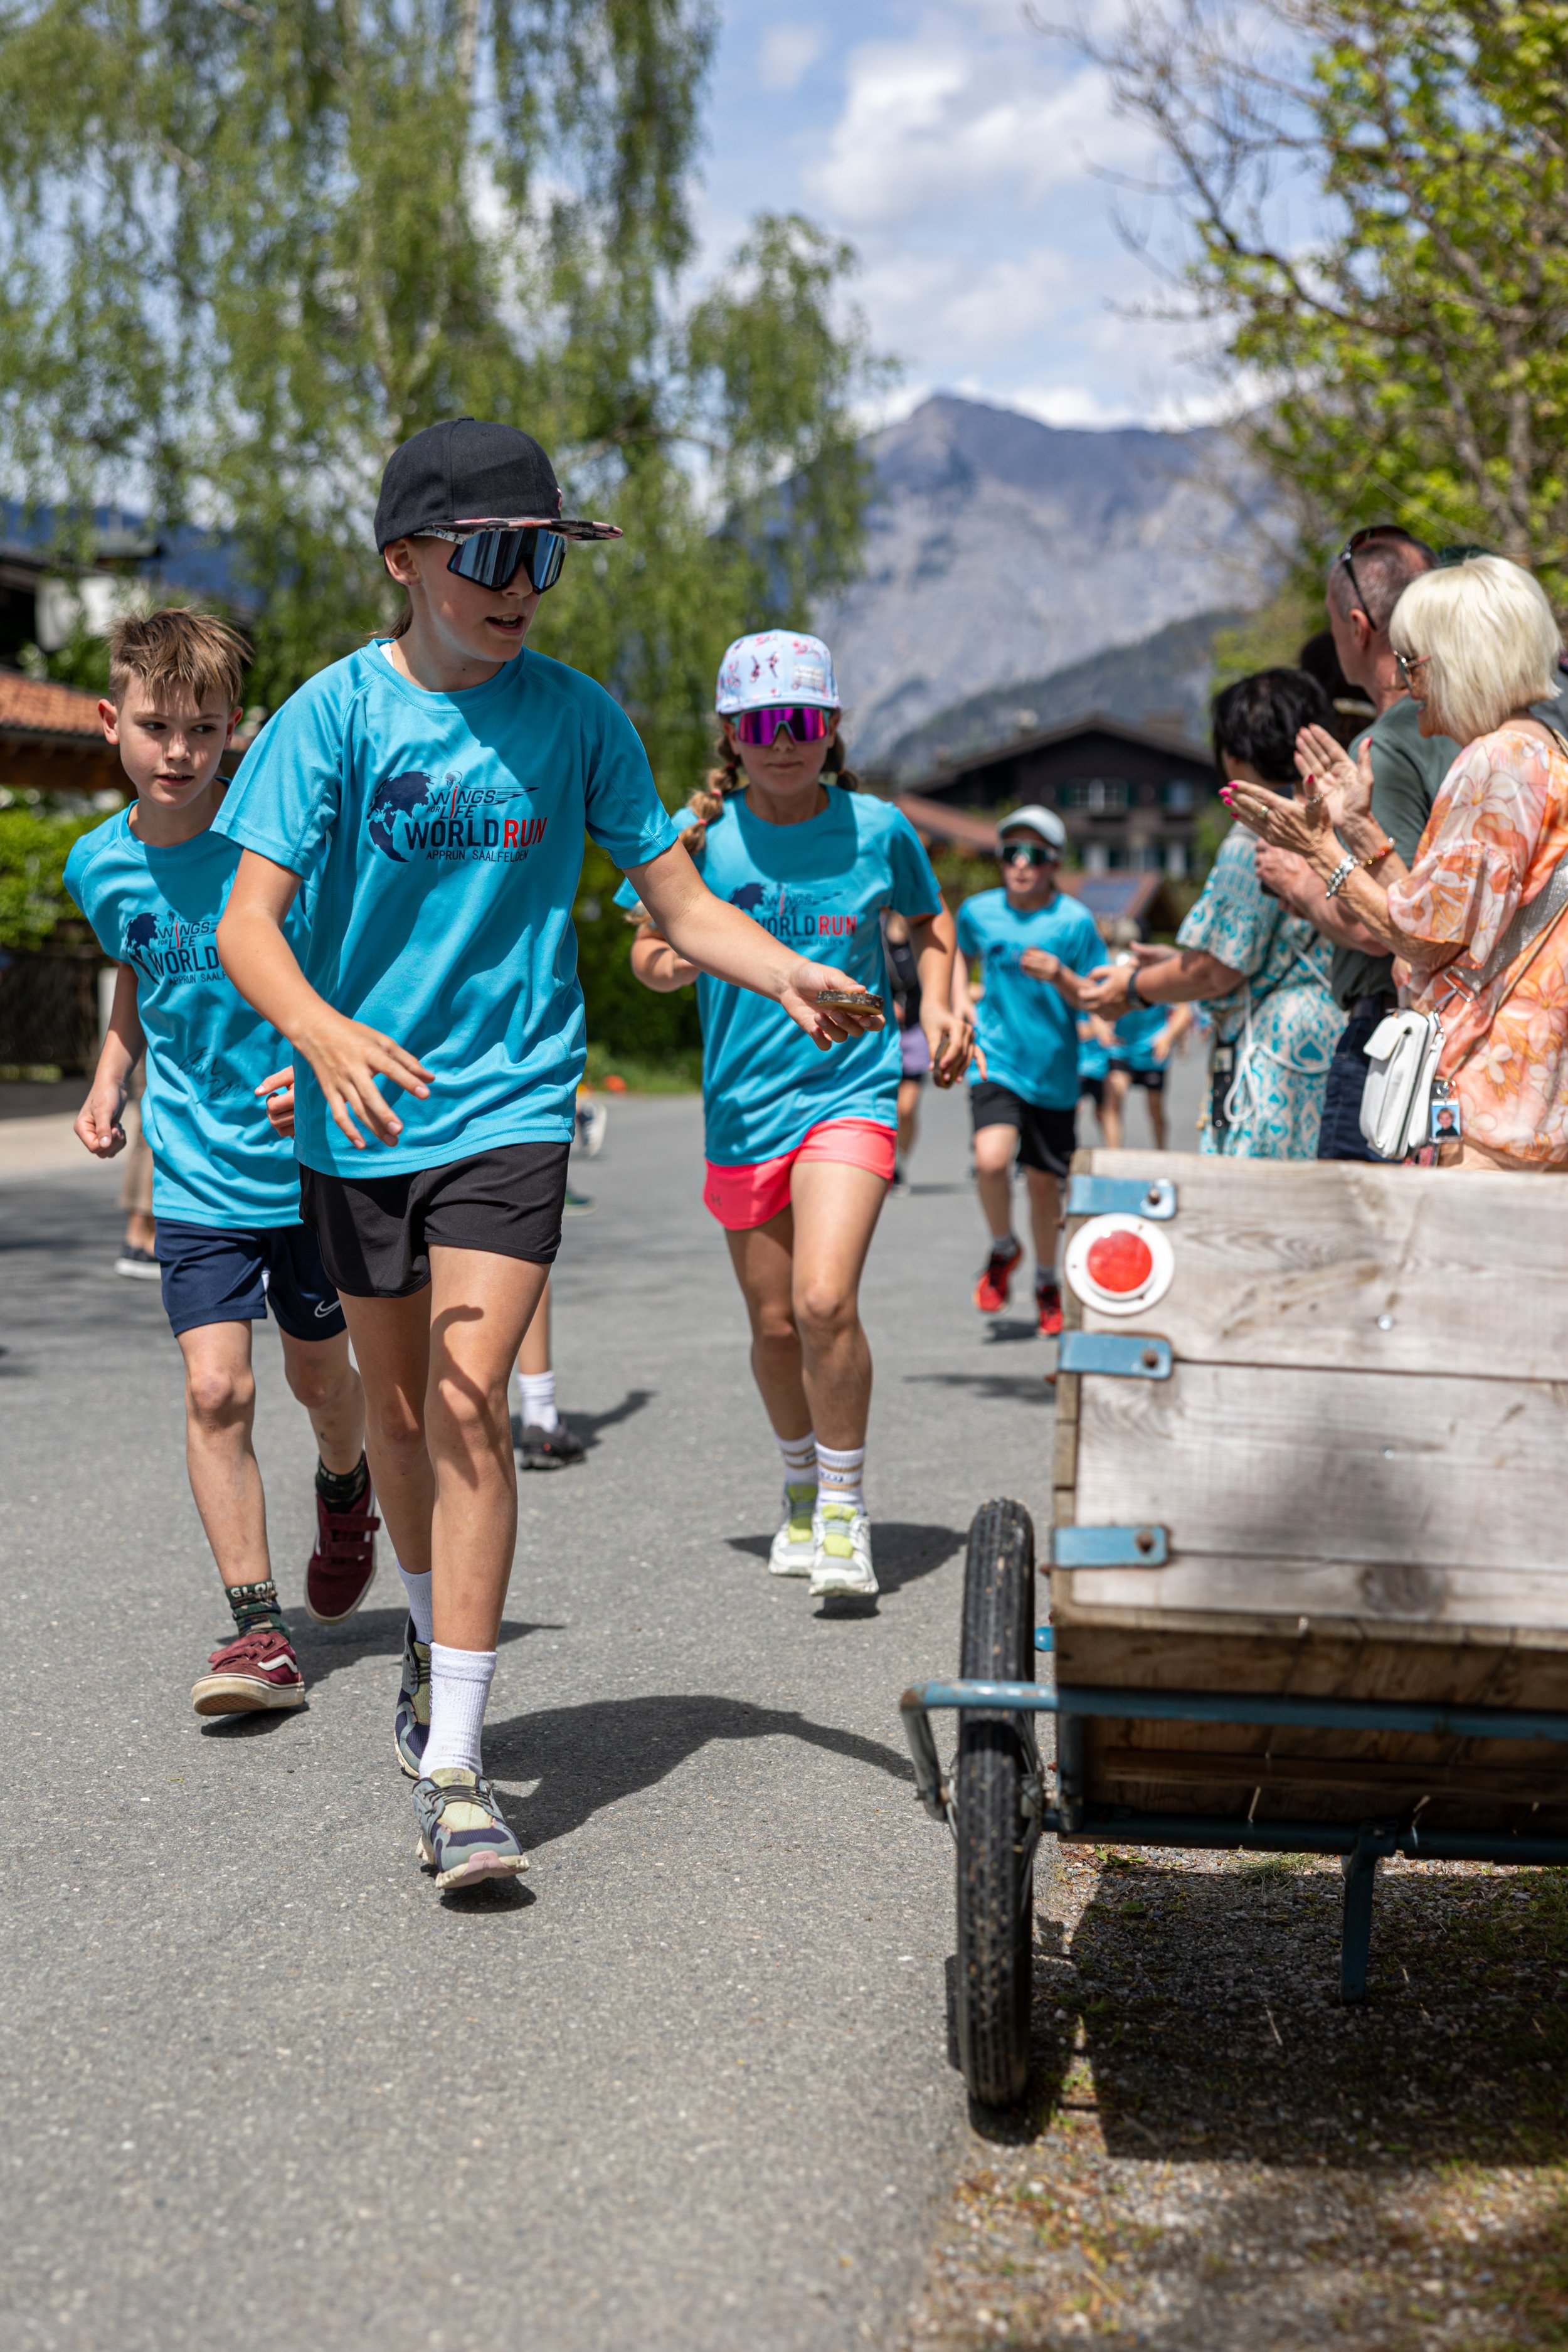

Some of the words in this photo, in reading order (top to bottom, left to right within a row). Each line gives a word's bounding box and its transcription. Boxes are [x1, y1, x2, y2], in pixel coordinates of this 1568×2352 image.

[440, 805, 477, 819] LIFE
[405, 818, 499, 850] WORLD
[504, 817, 548, 849] RUN
[426, 849, 465, 860] APPRUN
[472, 849, 529, 862] SAALFELDEN
[818, 914, 857, 936] RUN
[169, 935, 197, 950] LIFE
[148, 946, 220, 977] WORLD
[169, 974, 196, 986] APPRUN
